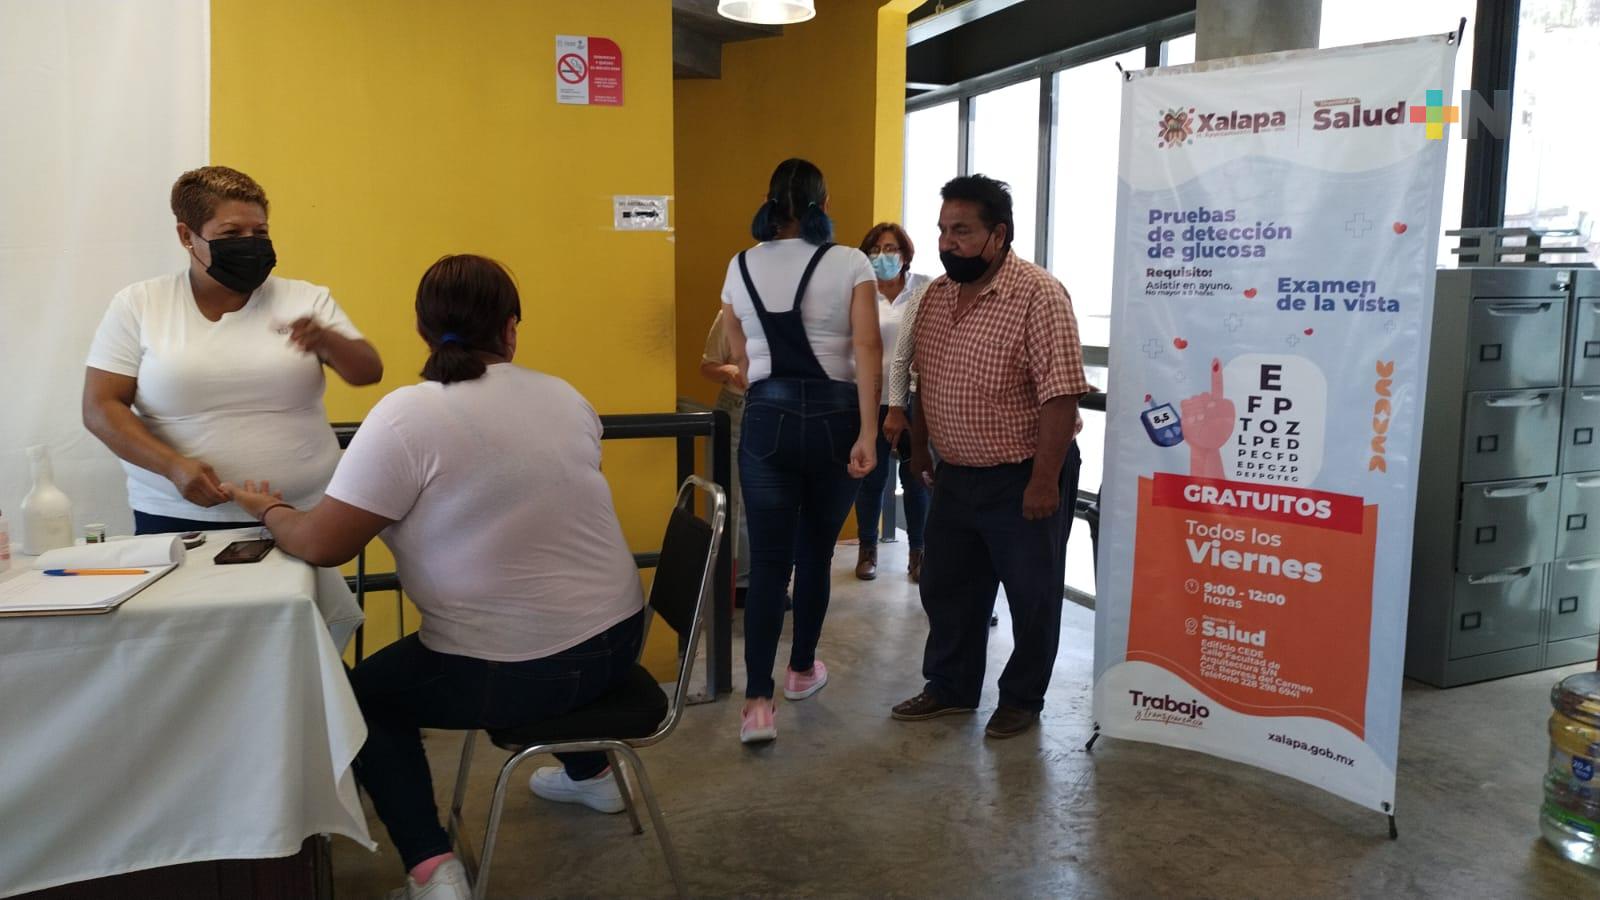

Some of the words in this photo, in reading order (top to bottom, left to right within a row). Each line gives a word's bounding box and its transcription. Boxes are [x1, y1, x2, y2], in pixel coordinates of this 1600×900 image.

[1197, 110, 1287, 134] Xalapa
[1312, 101, 1406, 131] Salud
[1149, 207, 1236, 224] Pruebas
[1148, 227, 1175, 242] de
[1182, 222, 1292, 241] detección
[1148, 243, 1175, 258] de
[1182, 243, 1266, 262] glucosa
[1146, 267, 1213, 279] Requisito:
[1146, 281, 1181, 290] Asistir
[1278, 277, 1376, 293] Examen
[1277, 294, 1306, 311] de
[1315, 294, 1335, 311] la
[1344, 294, 1400, 312] vista
[1260, 364, 1282, 391] E
[1153, 412, 1170, 424] 8,5
[1184, 484, 1332, 520] GRATUITOS
[1186, 519, 1246, 543] Todos
[1251, 528, 1282, 547] los
[1186, 538, 1323, 583] Viernes
[1204, 582, 1236, 596] 9:00
[1248, 589, 1286, 606] 12:00
[1204, 592, 1243, 609] horas
[1202, 619, 1266, 647] Salud
[1201, 639, 1236, 653] Edificio
[1238, 646, 1264, 658] CEDE
[1201, 647, 1224, 658] Calle
[1226, 651, 1266, 667] Facultad
[1268, 661, 1280, 670] de
[1200, 655, 1259, 674] Arquitectura
[1261, 666, 1278, 677] S/N
[1241, 678, 1258, 688] 228
[1258, 674, 1274, 685] del
[1275, 677, 1313, 694] Carmen
[1129, 690, 1210, 720] Trabajo
[1267, 731, 1355, 767] xalapa.gob.mx
